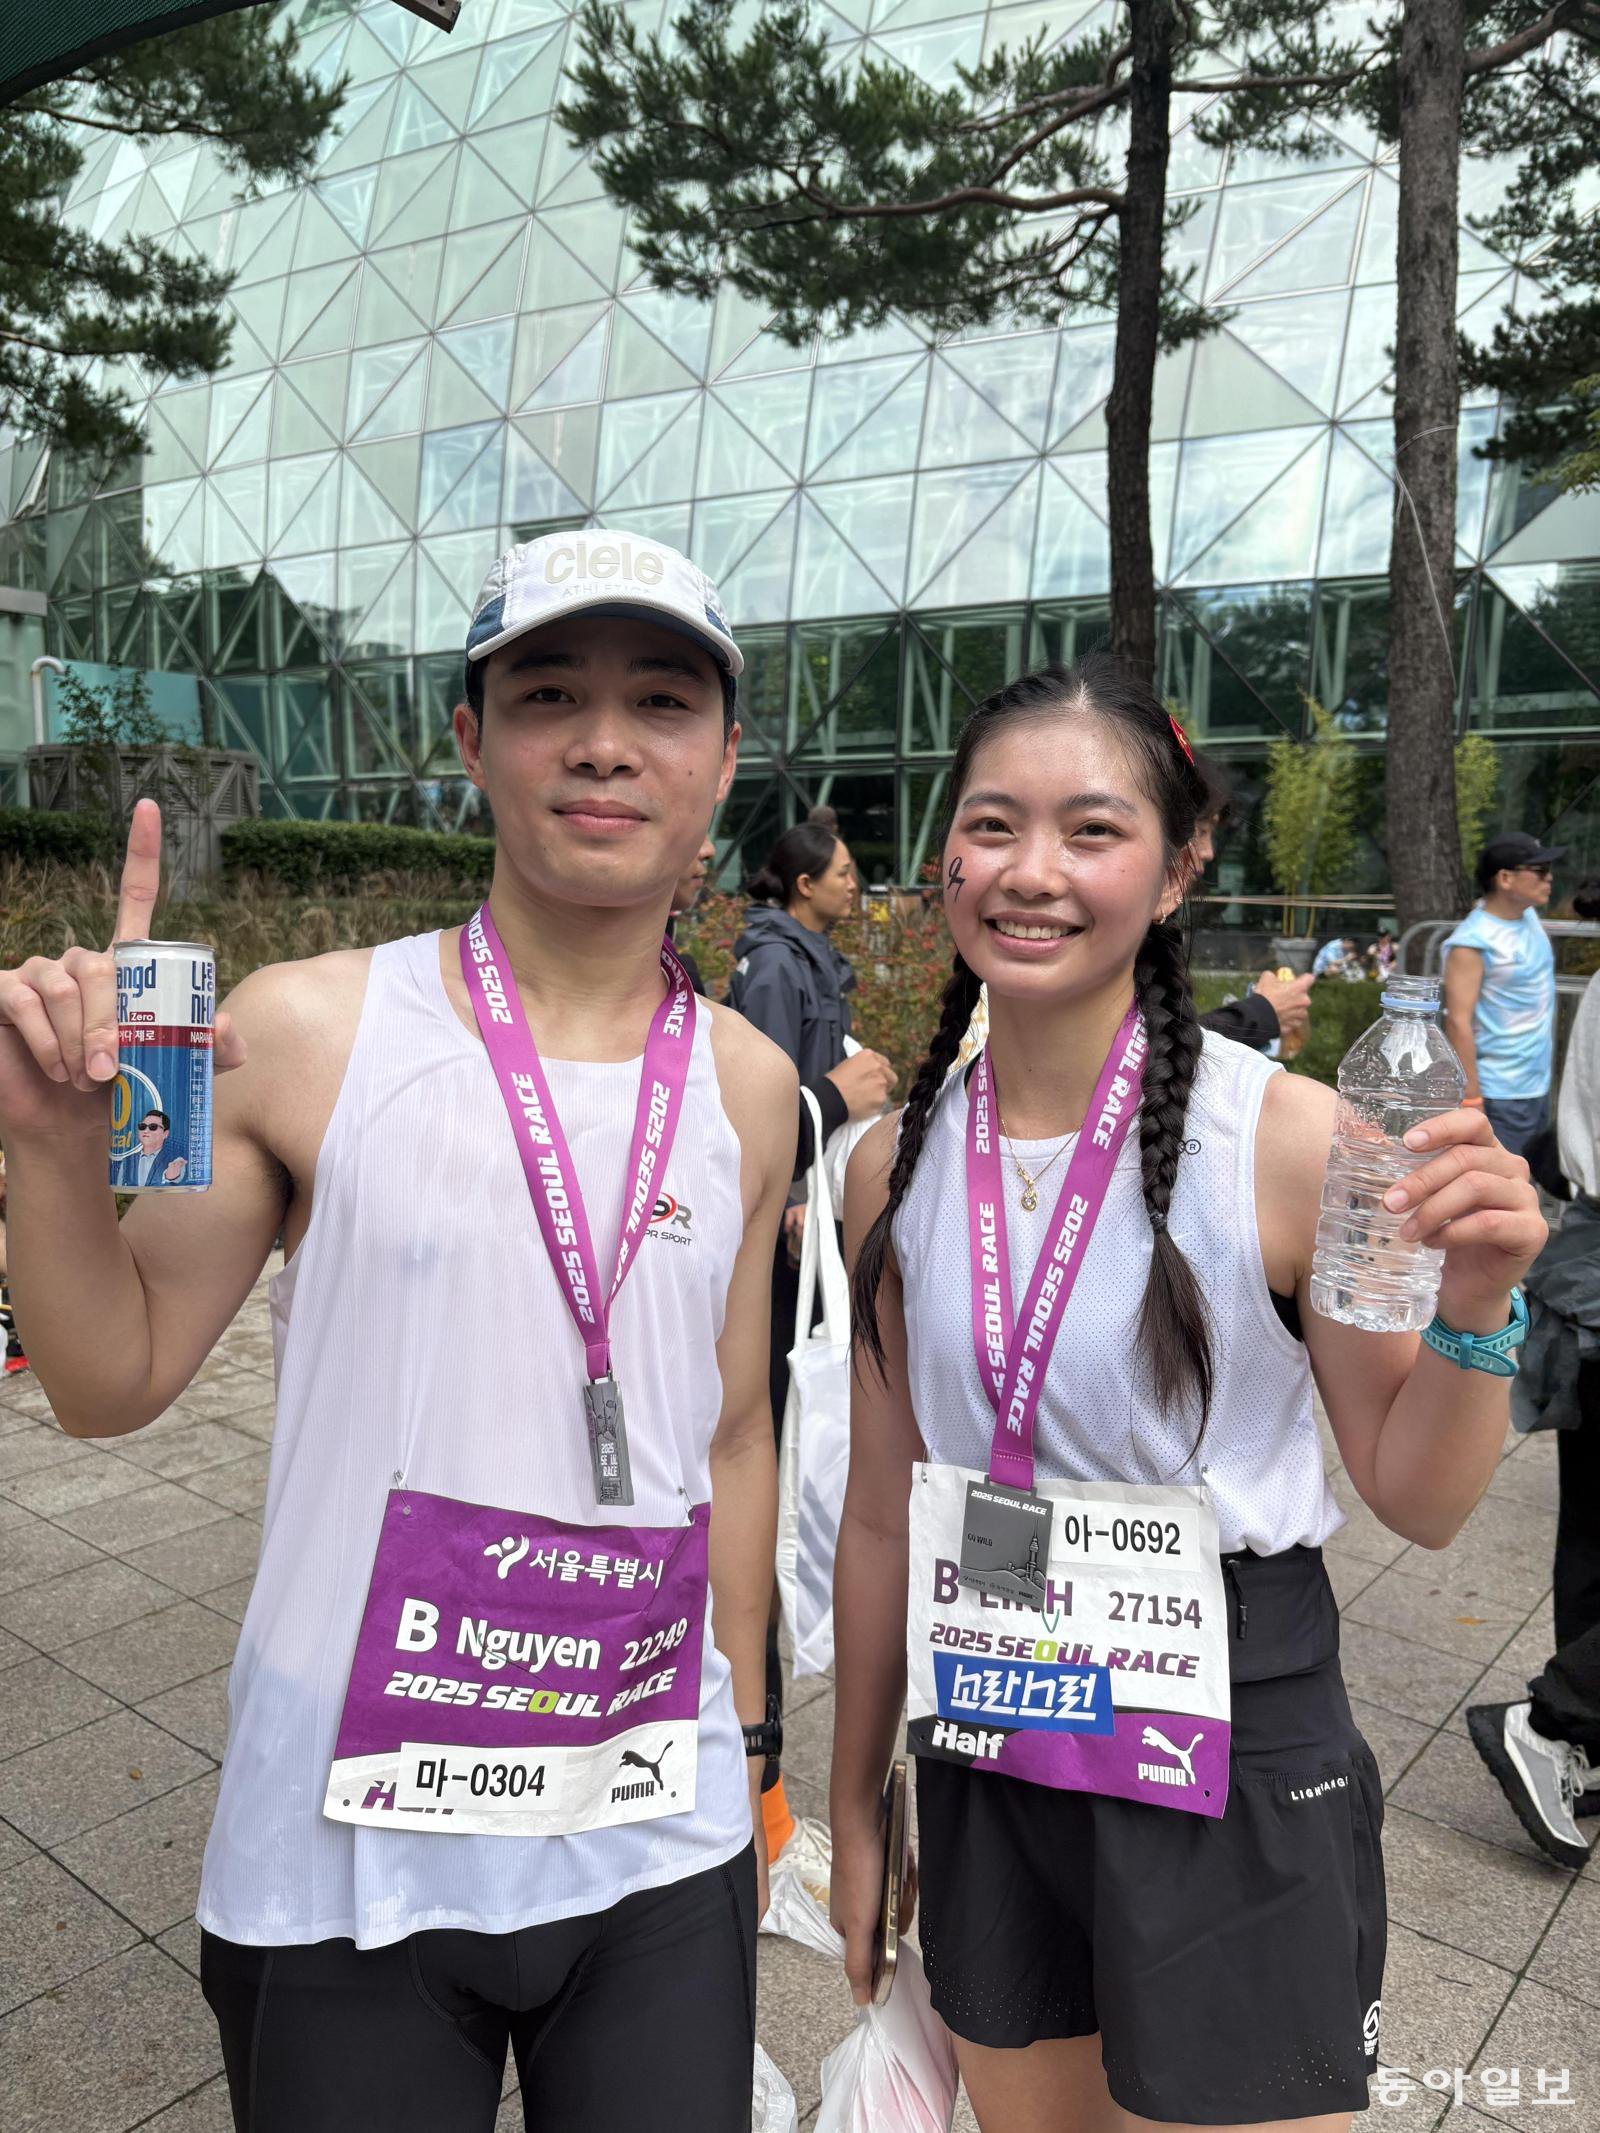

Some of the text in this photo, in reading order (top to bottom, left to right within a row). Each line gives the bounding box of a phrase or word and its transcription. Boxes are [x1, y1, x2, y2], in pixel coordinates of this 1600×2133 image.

[544, 541, 664, 585] ciele
[131, 1012, 153, 1021] Zero
[478, 965, 513, 1024] 2025
[663, 989, 688, 1038] RACE
[646, 1080, 671, 1148] 2025
[976, 1096, 990, 1154] 2025
[1092, 1074, 1131, 1150] RACE
[511, 1072, 595, 1324] 2025 SEOUL RACE
[626, 1144, 656, 1233] SEOUL
[661, 1232, 692, 1246] SPORT
[979, 1202, 999, 1273] RACE
[983, 1278, 1006, 1369] SEOUL
[1006, 1193, 1088, 1437] 2025 SEOUL RACE
[603, 1466, 618, 1477] RACE
[971, 1490, 1047, 1516] 2025 SEOUL RACE
[1064, 1514, 1181, 1555] 아-0692
[529, 1548, 664, 1589] 서울특별시
[933, 1558, 959, 1604] B
[1108, 1590, 1202, 1629] 27154
[395, 1597, 688, 1674] B Nguyen 22249
[929, 1622, 1200, 1678] 2025 SEOUL RACE
[384, 1667, 677, 1717] 2025 SEOUL RACE
[932, 1720, 1003, 1759] Half
[416, 1758, 545, 1797] 마-0304
[611, 1780, 656, 1803] PUMA
[1137, 1762, 1188, 1787] PUMA
